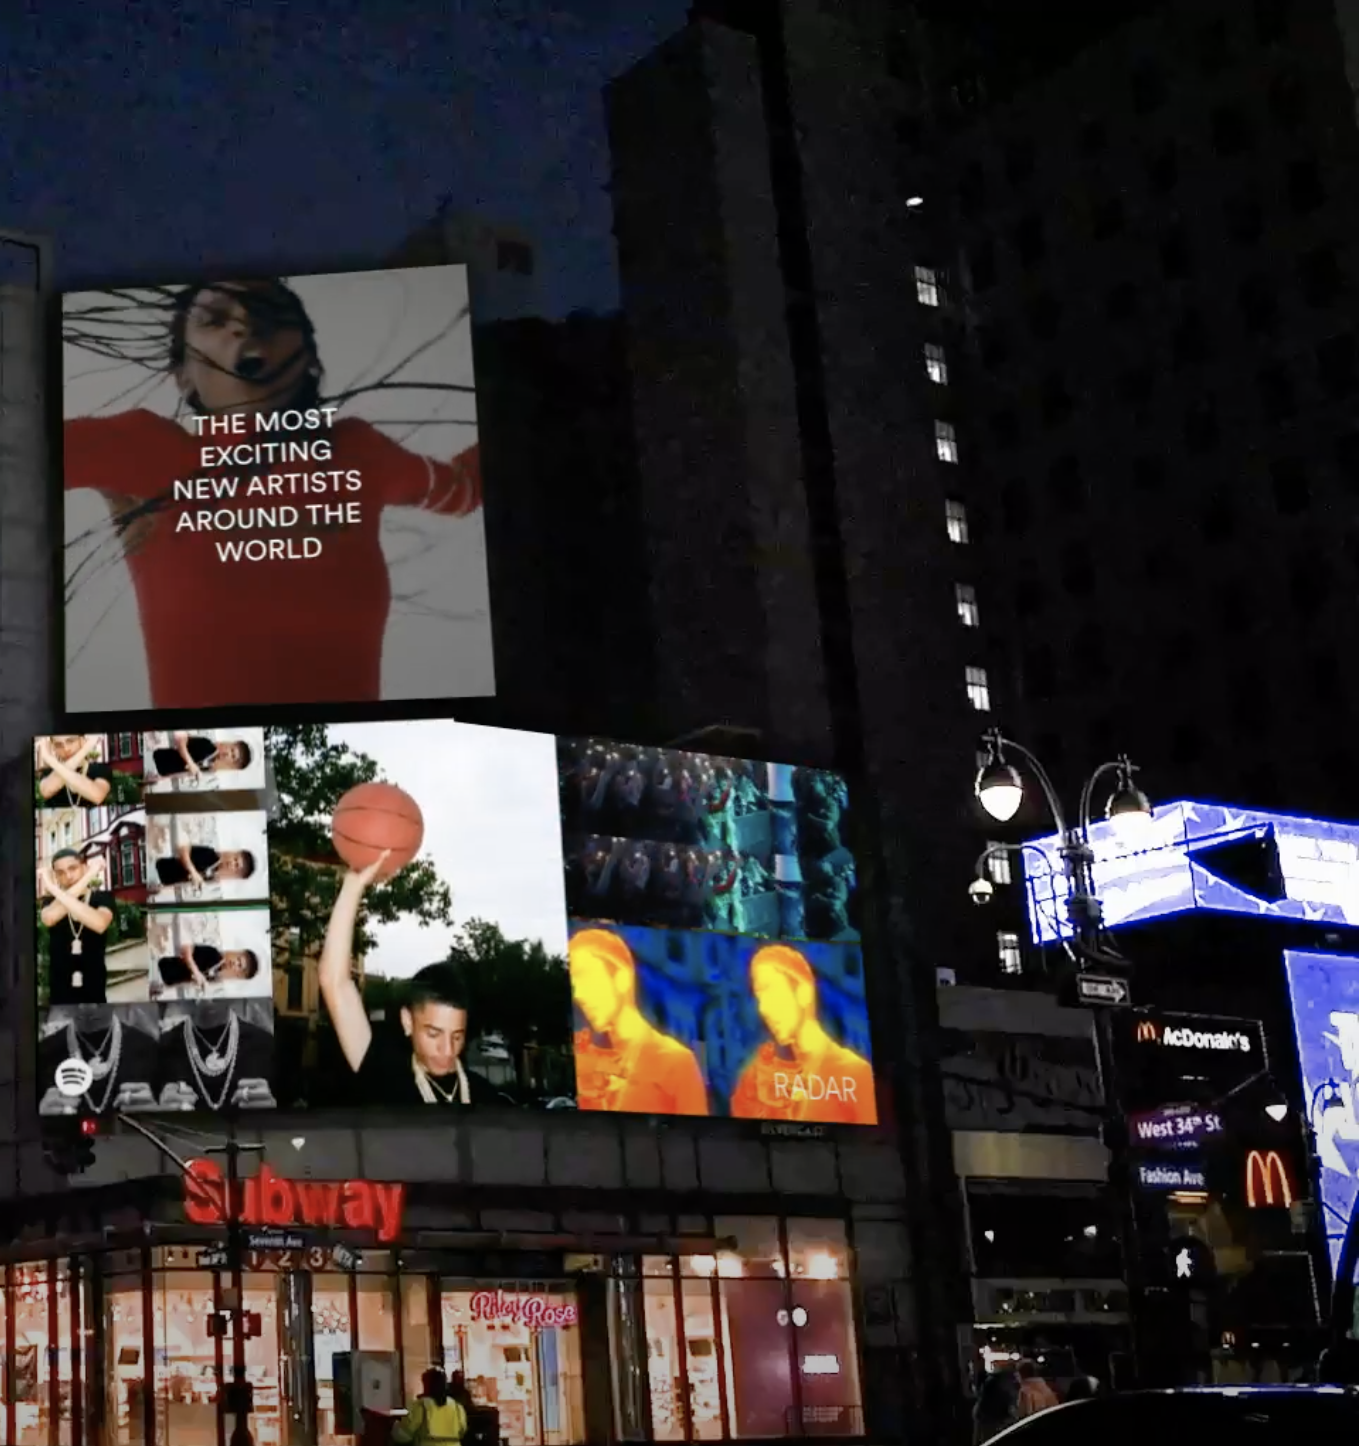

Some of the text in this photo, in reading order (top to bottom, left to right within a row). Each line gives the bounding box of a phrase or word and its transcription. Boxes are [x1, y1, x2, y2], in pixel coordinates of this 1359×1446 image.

[192, 407, 338, 436] THE MOST
[200, 439, 332, 467] EXCITING
[173, 469, 362, 500] NEW ARTISTS
[175, 502, 362, 532] AROUND THE
[215, 537, 323, 562] WORLD
[773, 1071, 858, 1103] RADAR
[1137, 1119, 1174, 1139] West
[1205, 1113, 1223, 1132] St
[1139, 1166, 1206, 1186] Fashion Ave
[183, 1157, 405, 1243] Subway
[469, 1288, 579, 1327] Riley Rose
